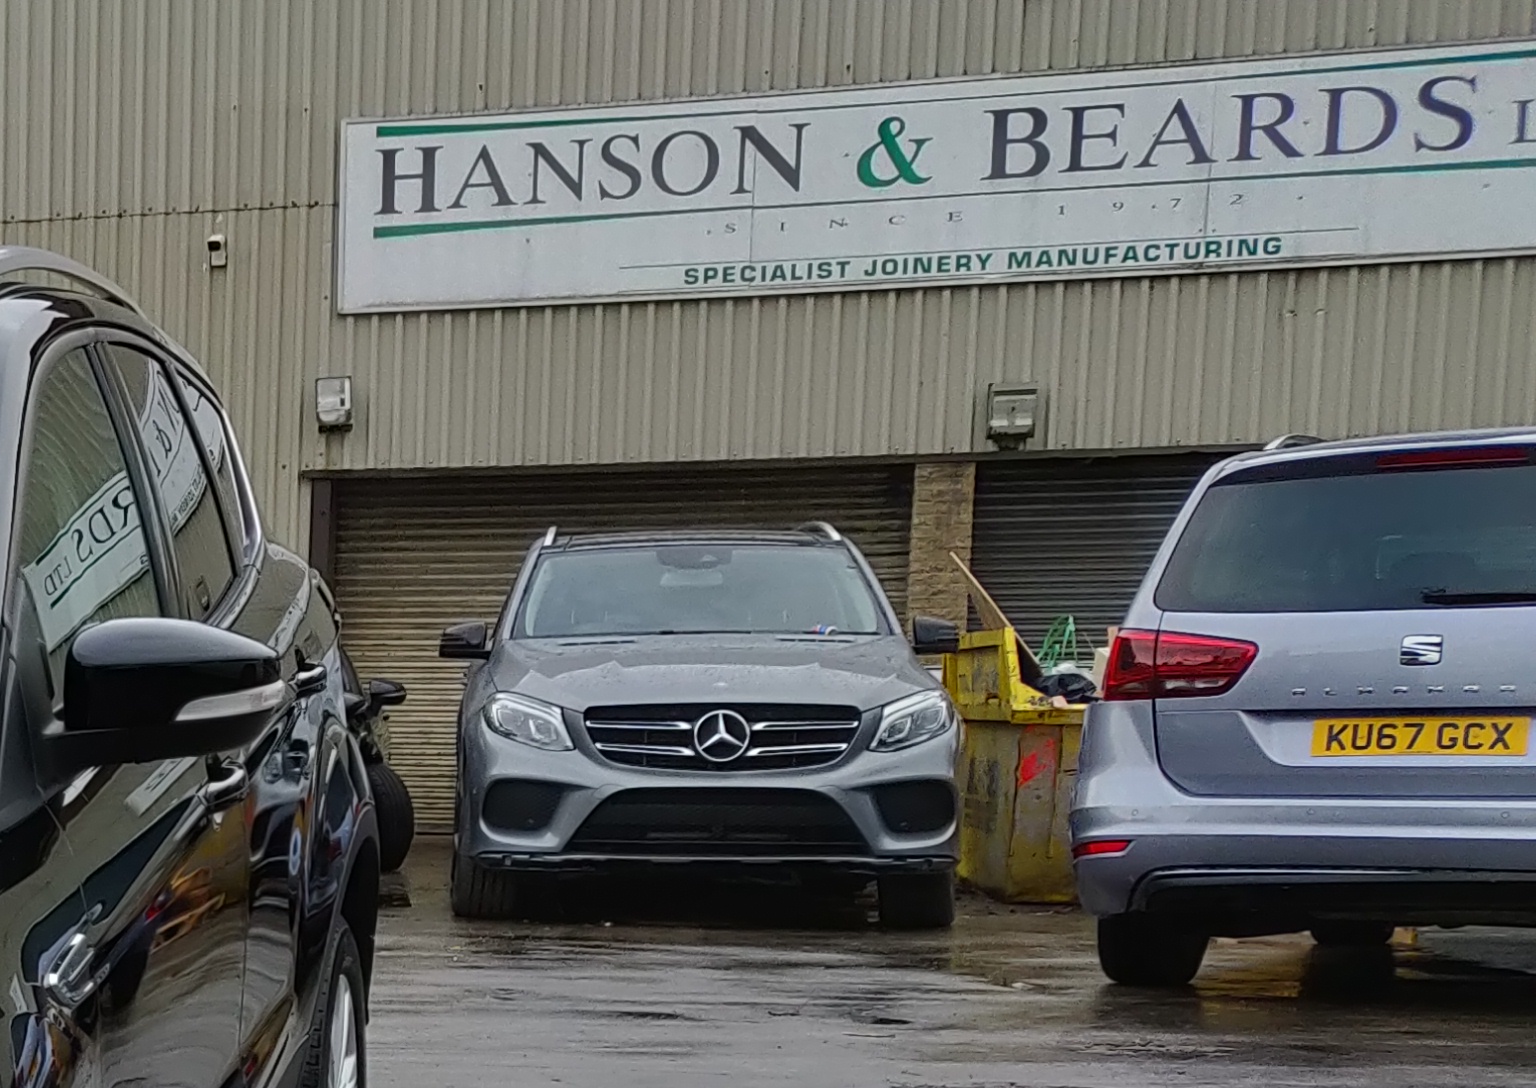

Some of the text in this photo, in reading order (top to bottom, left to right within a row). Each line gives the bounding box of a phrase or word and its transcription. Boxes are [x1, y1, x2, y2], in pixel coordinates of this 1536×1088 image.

[374, 122, 812, 215] HANSON
[856, 116, 934, 188] &
[979, 75, 1478, 181] BEARDS
[724, 194, 1245, 233] SINCE 1972
[683, 236, 1283, 285] SPECIALIST JOINERY MANUFACTURING
[1325, 722, 1514, 752] KU67 GCX
